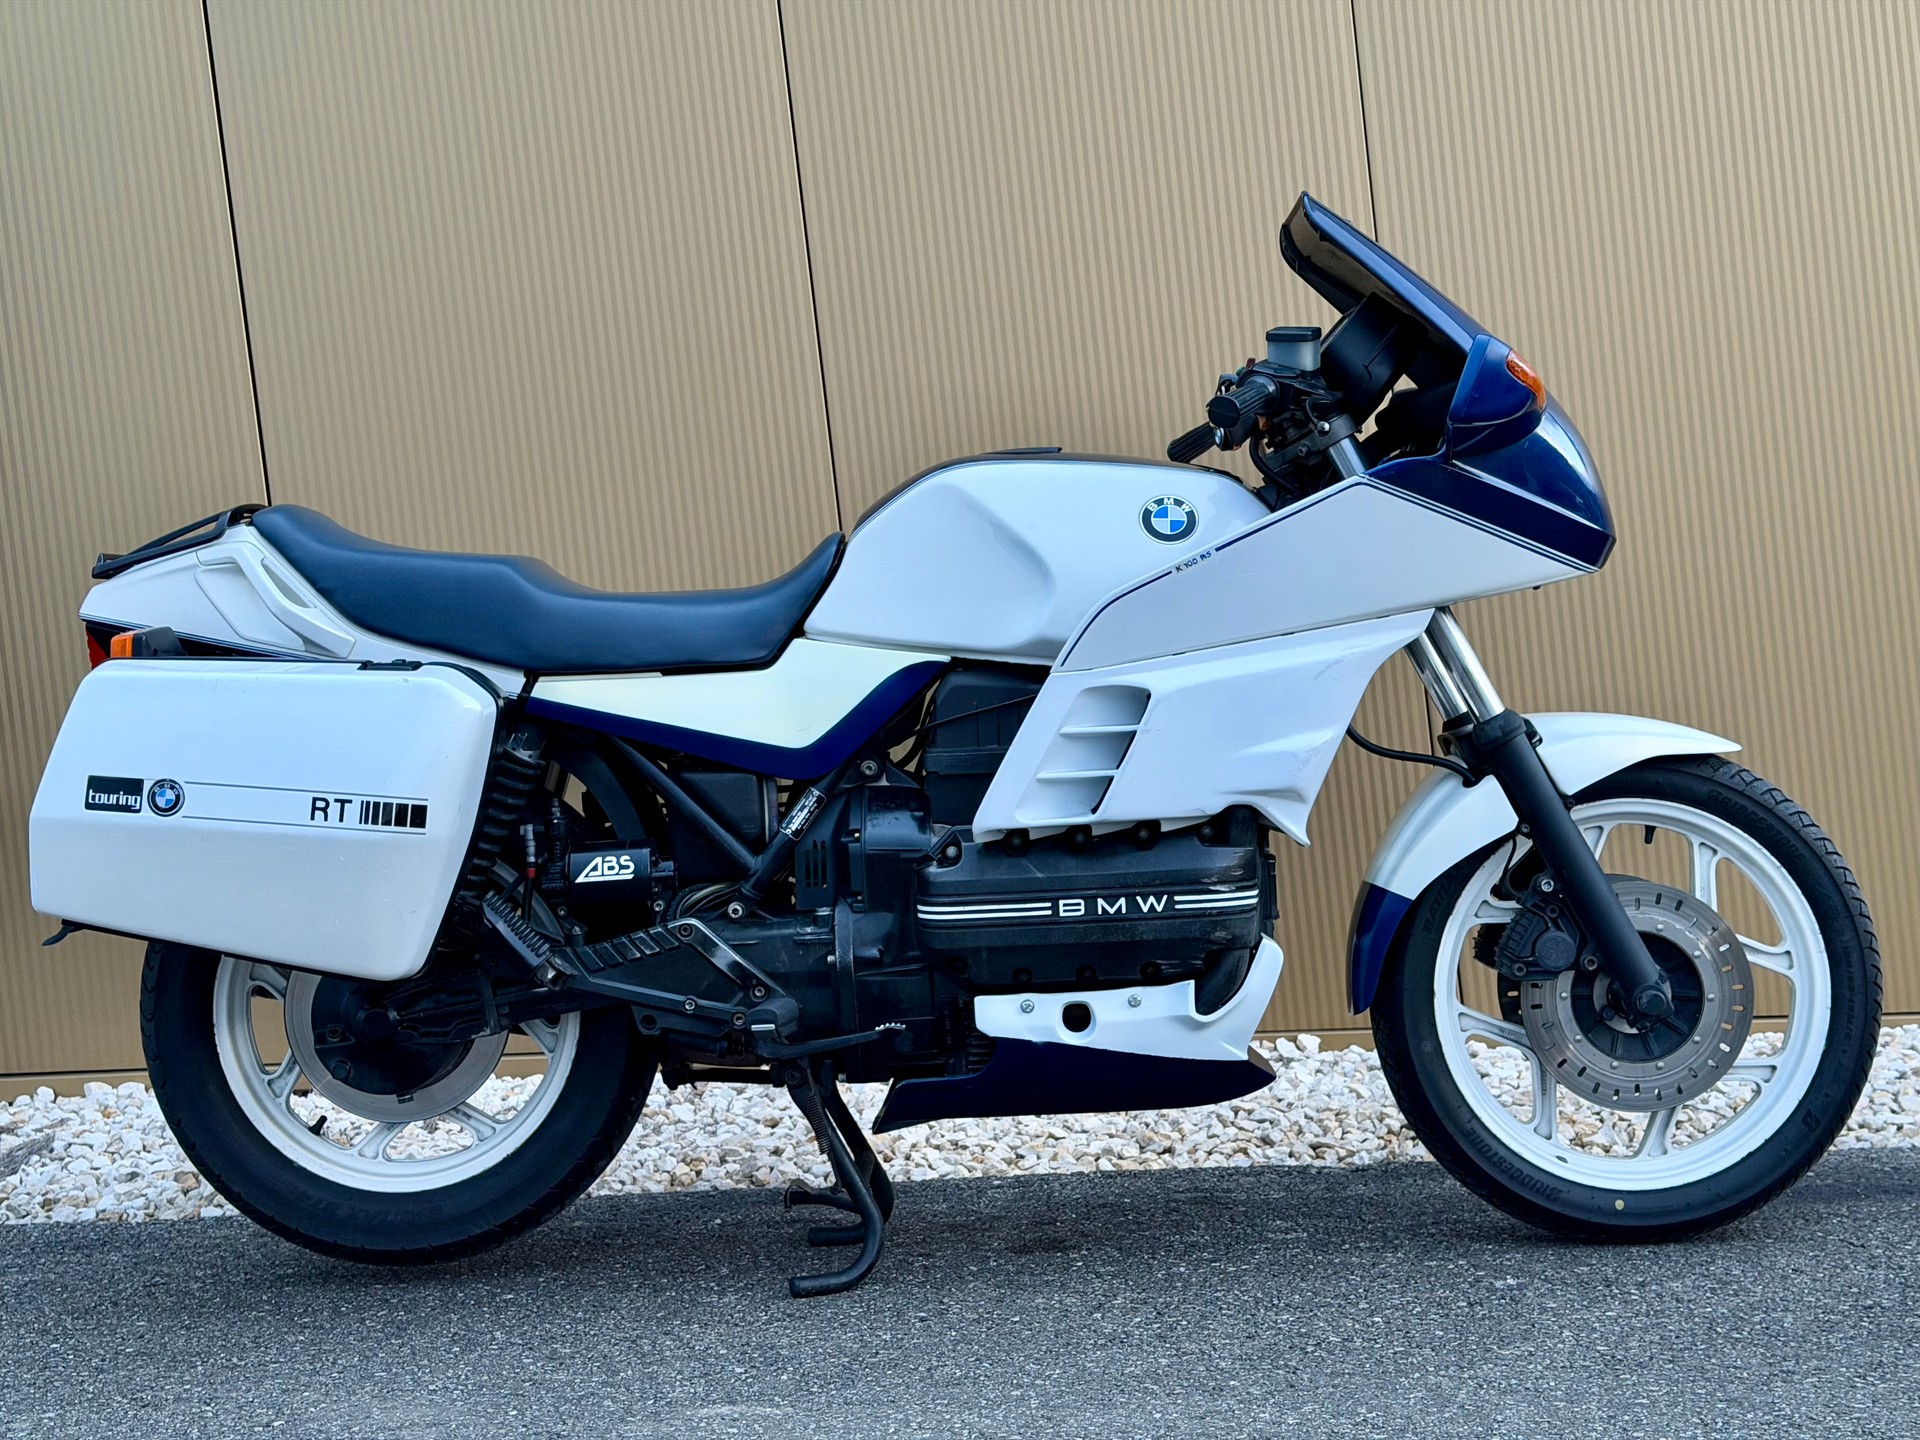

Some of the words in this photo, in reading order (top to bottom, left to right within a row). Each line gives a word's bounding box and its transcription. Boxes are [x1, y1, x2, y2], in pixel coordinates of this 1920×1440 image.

[1147, 497, 1192, 512] BMW
[1175, 564, 1183, 573] K
[1184, 558, 1198, 568] 100
[1200, 551, 1211, 561] RS
[88, 788, 141, 810] touring
[153, 783, 180, 795] BMW
[310, 796, 353, 823] RT
[575, 855, 635, 884] ABS
[1058, 894, 1168, 917] BMW
